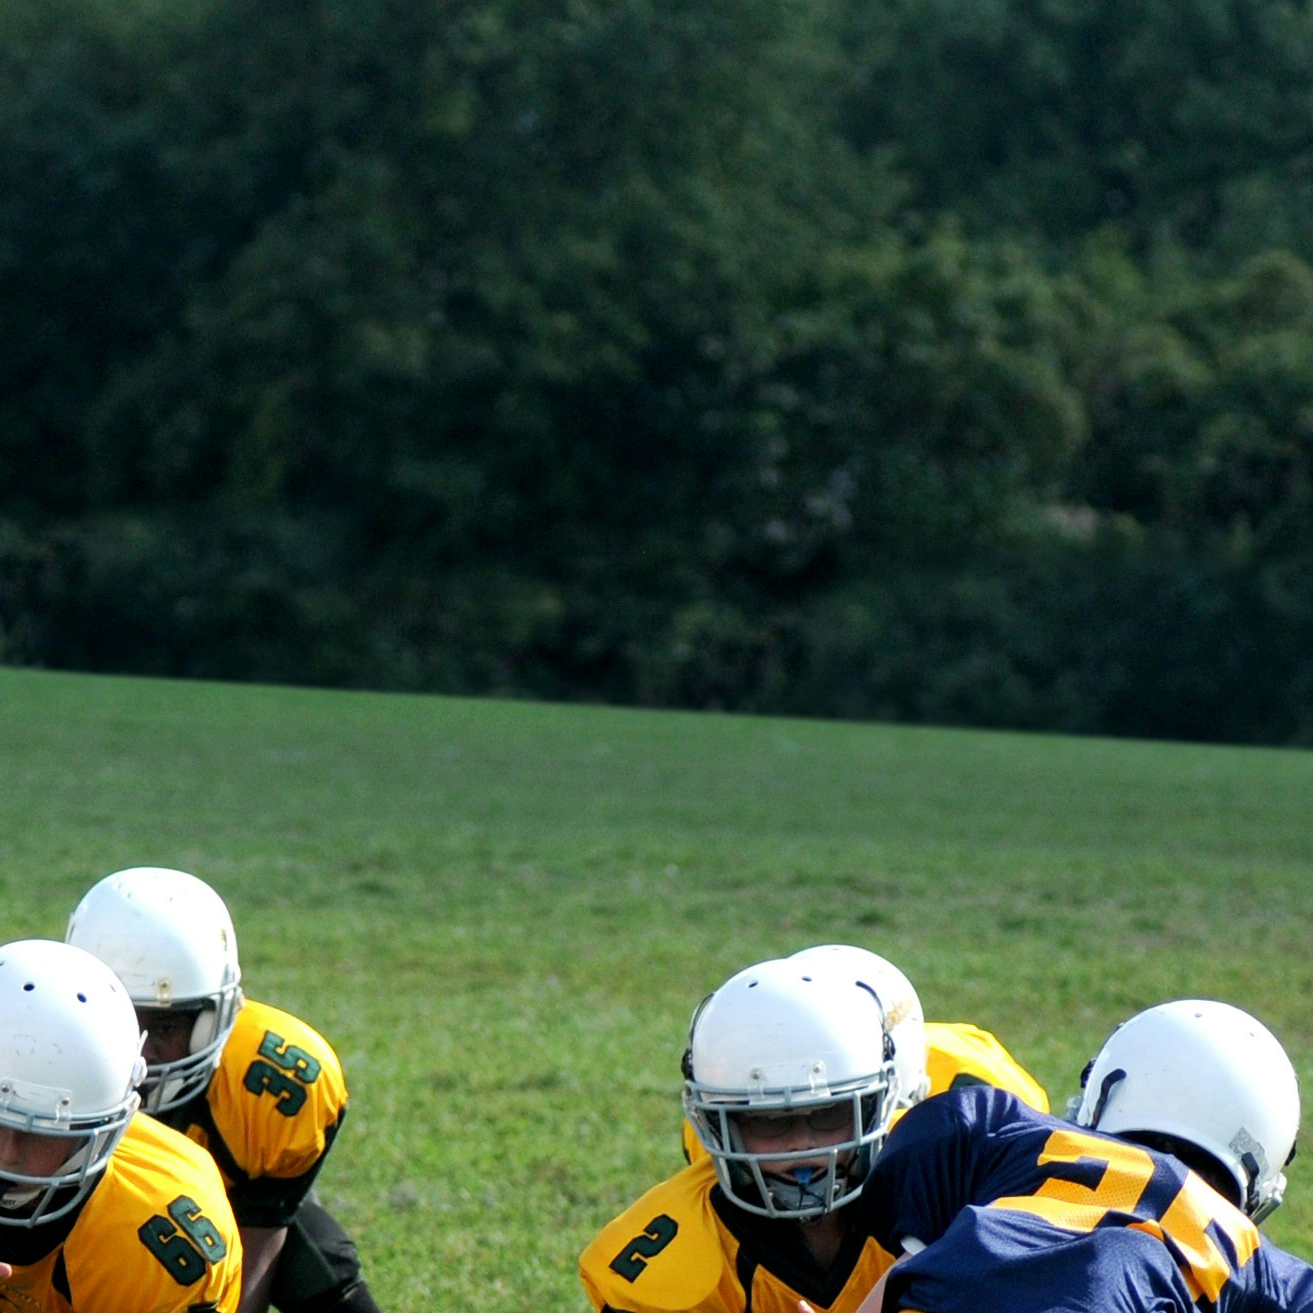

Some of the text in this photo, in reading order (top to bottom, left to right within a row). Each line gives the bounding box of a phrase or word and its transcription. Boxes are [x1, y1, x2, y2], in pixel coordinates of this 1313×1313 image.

[243, 1030, 322, 1117] 35
[137, 1194, 227, 1287] 66
[608, 1213, 680, 1284] 2
